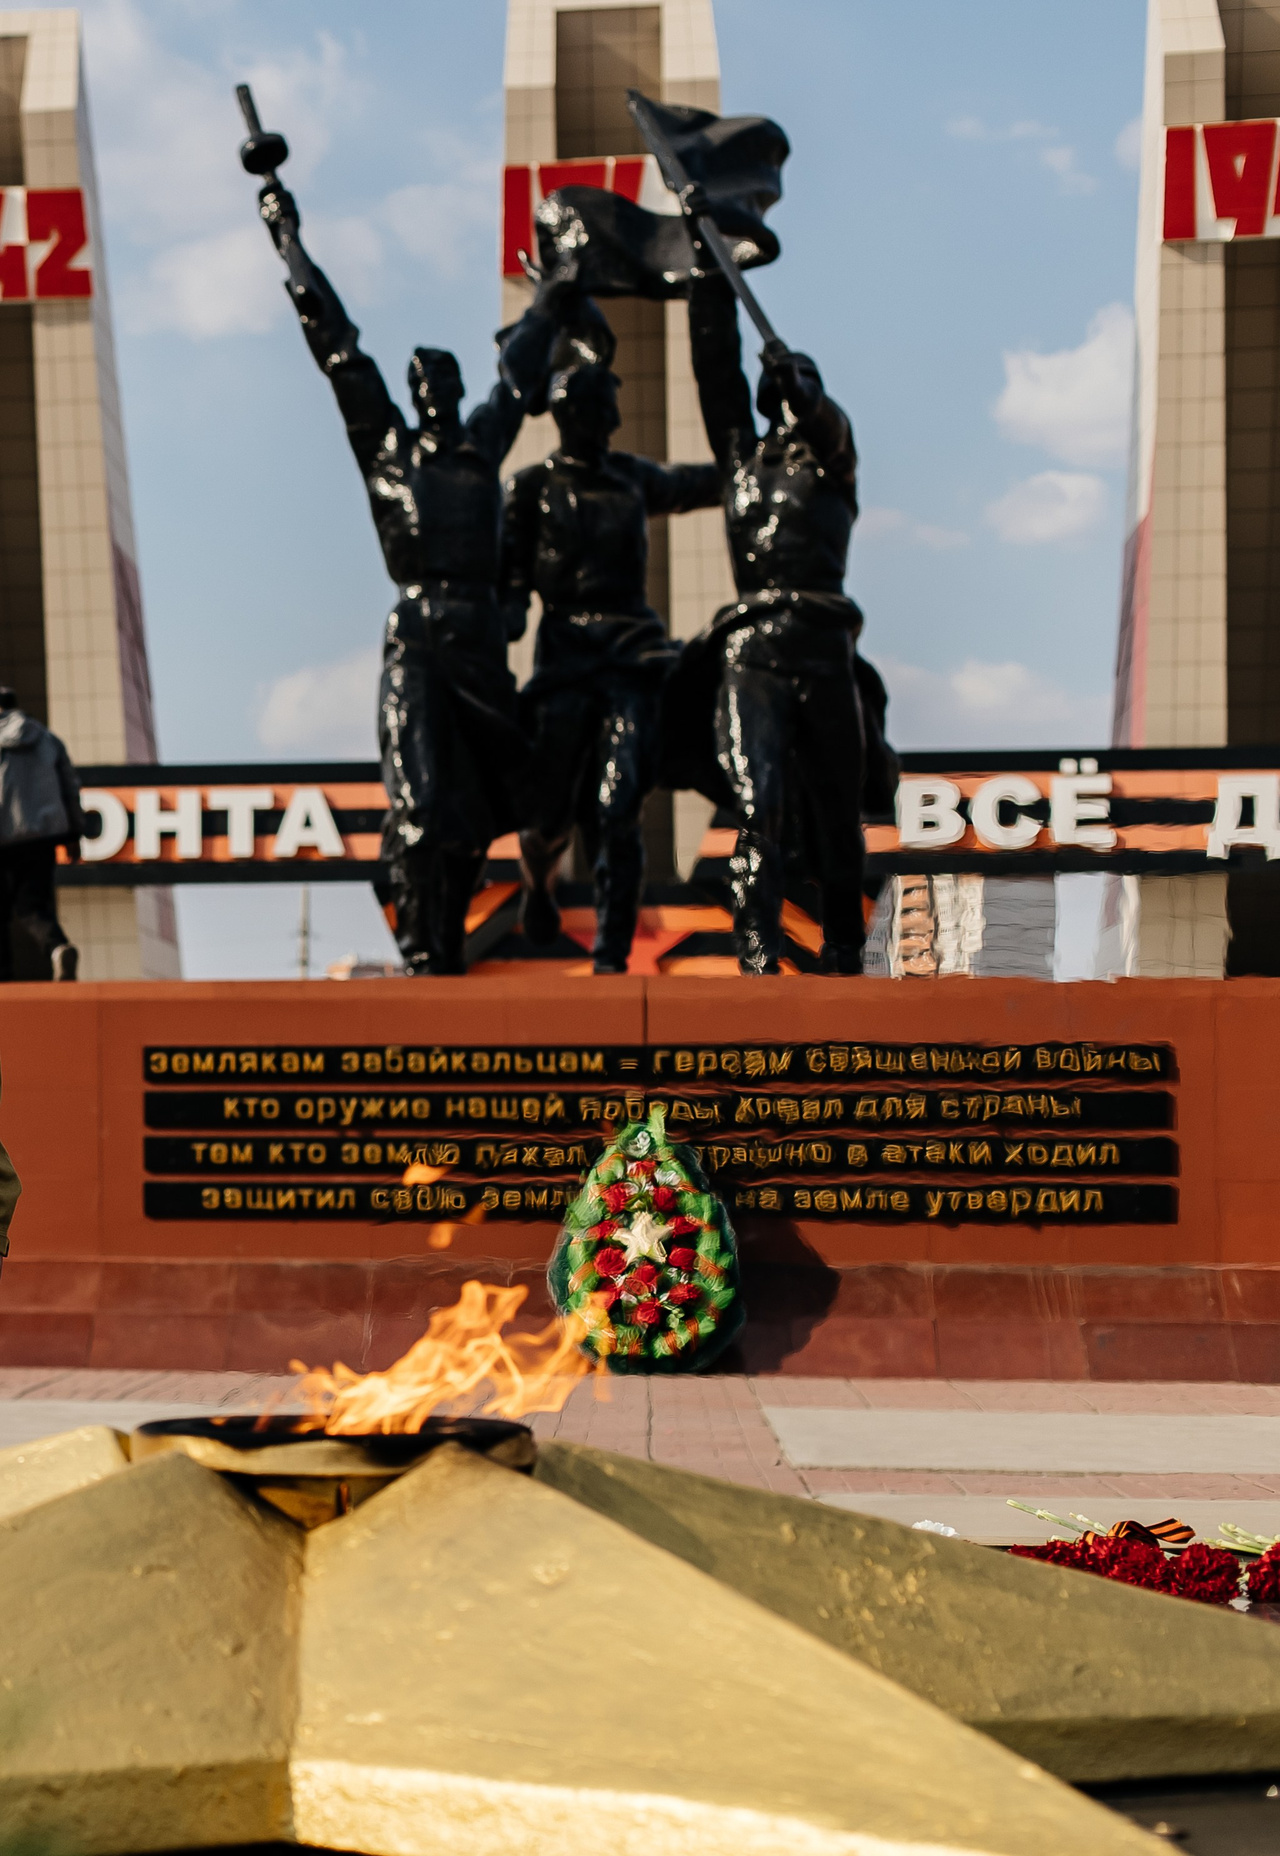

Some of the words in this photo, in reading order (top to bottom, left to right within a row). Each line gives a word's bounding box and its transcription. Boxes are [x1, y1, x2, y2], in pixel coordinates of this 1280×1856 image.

[1162, 118, 1280, 242] 19
[894, 757, 1117, 852] ВСЁ
[149, 1051, 325, 1073] землякам
[341, 1045, 605, 1075] забайкальцам
[223, 1097, 280, 1119] кто
[295, 1097, 431, 1126] оружие
[446, 1092, 565, 1123] нашей
[191, 1142, 254, 1164] тем
[269, 1142, 327, 1164] кто
[1003, 1142, 1120, 1167] ходил
[200, 1187, 356, 1211] защитил
